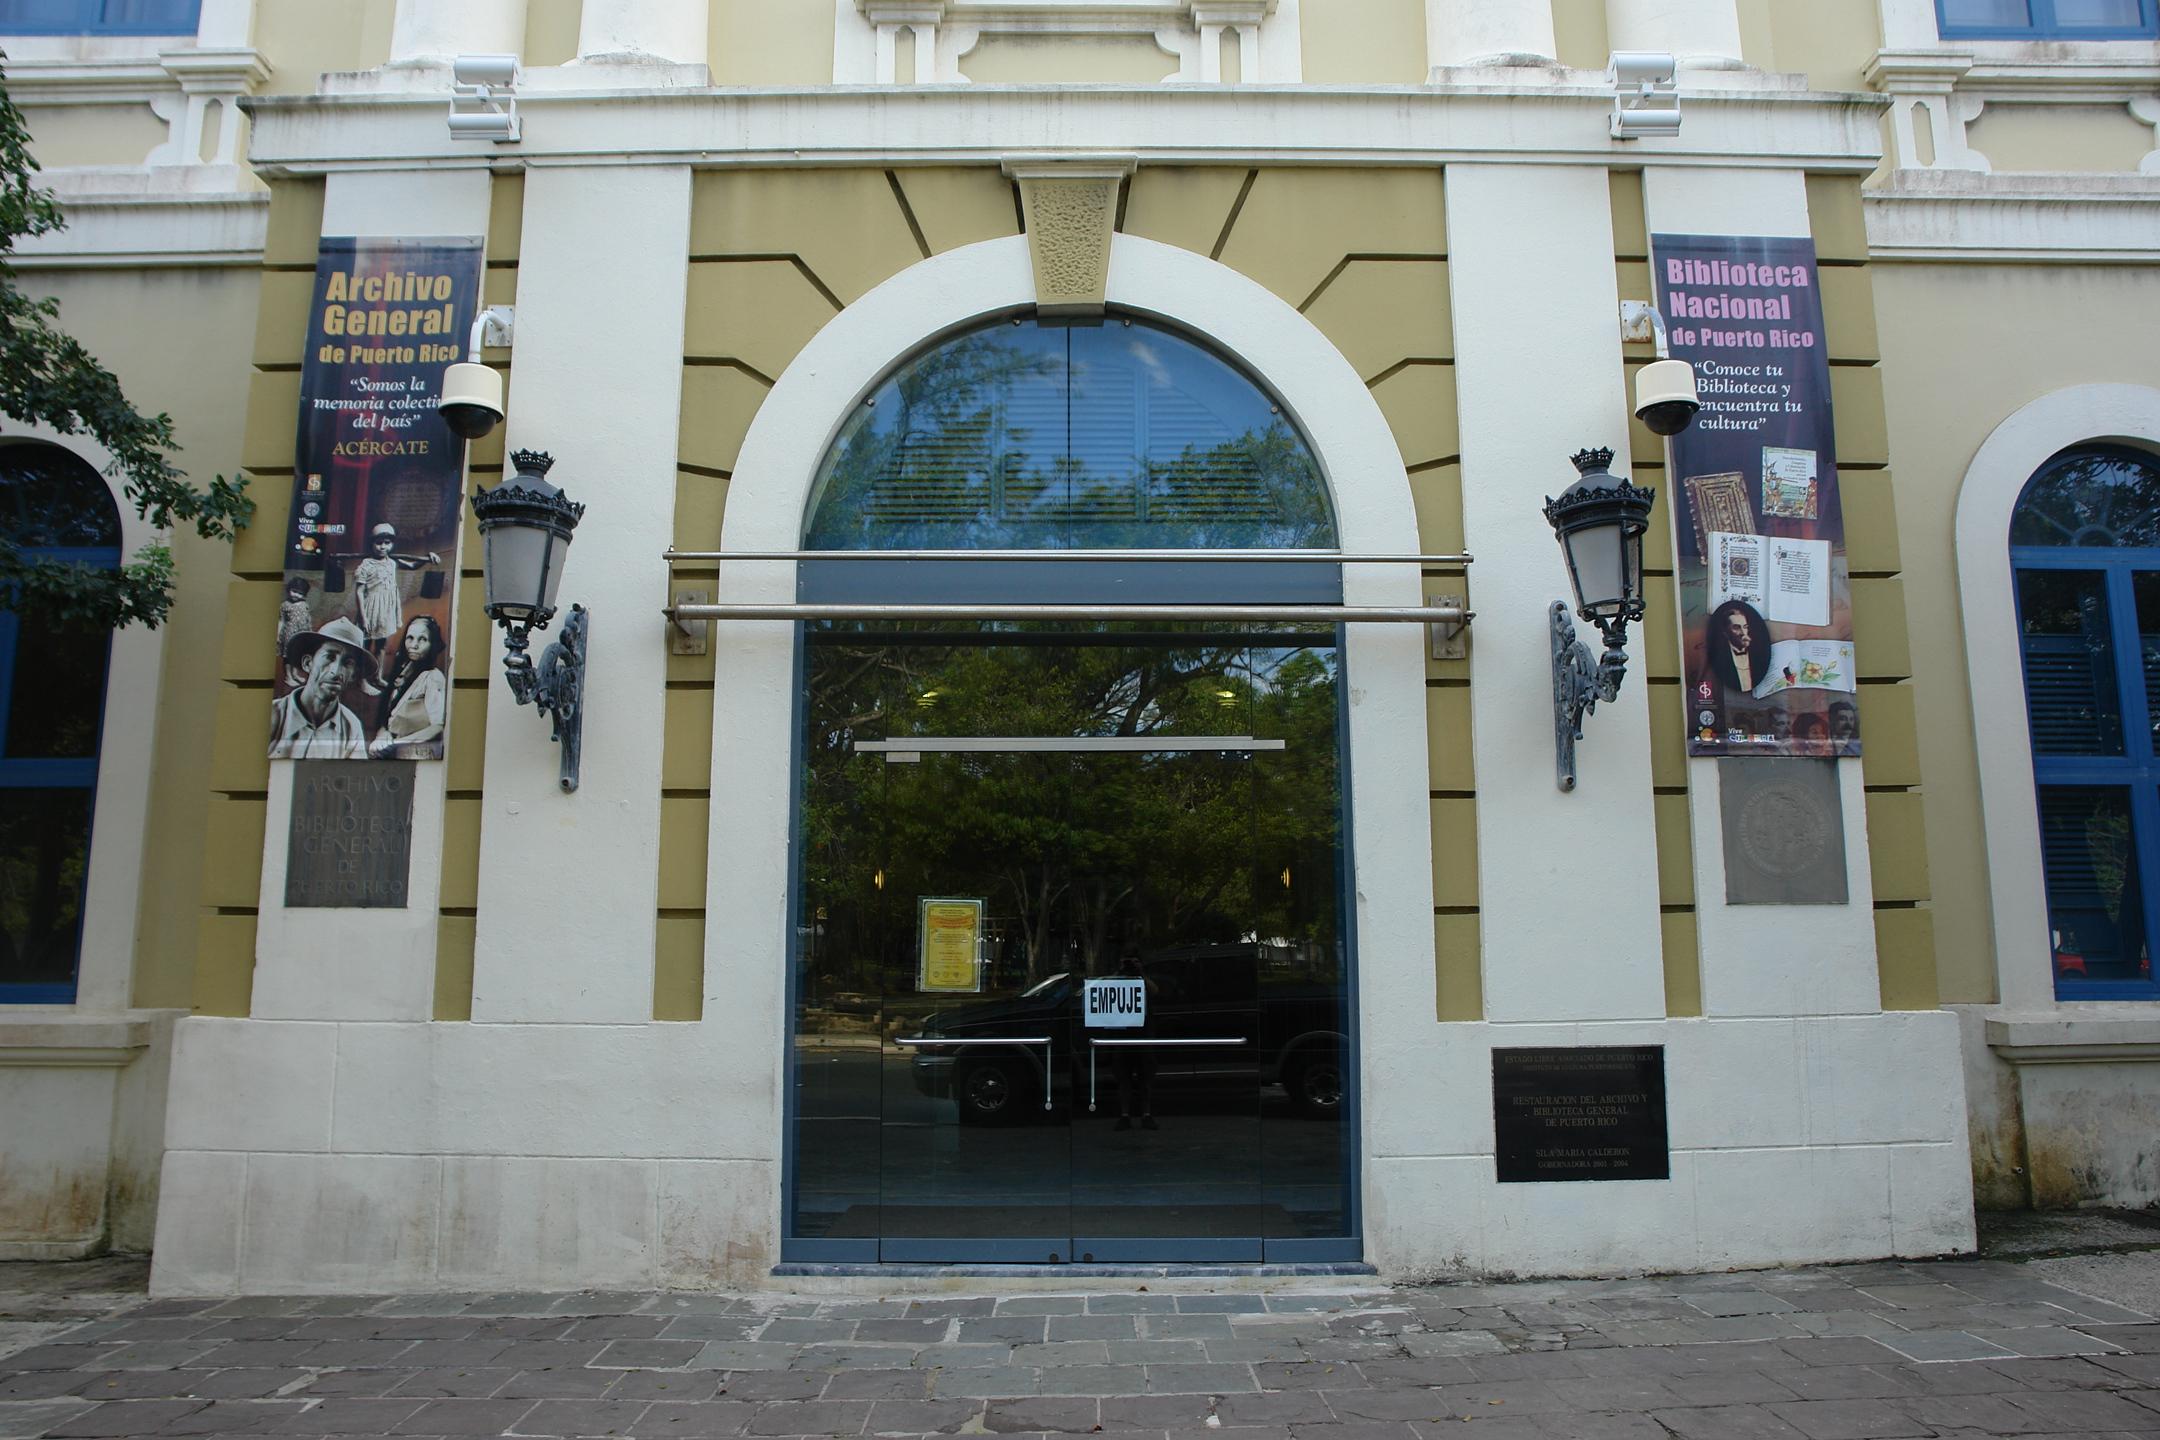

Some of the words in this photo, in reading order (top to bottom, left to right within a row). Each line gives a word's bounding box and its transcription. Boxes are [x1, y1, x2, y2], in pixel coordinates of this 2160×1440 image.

[1666, 258, 1809, 287] Biblioteca
[326, 271, 453, 301] Archivo
[1669, 291, 1791, 320] Nacional
[323, 304, 454, 336] General
[1672, 327, 1696, 346] de
[1700, 328, 1765, 348] Puerto
[1769, 330, 1814, 348] Rico
[319, 344, 345, 363] de
[350, 344, 414, 364] Puerto
[419, 344, 459, 362] Rico
[1694, 360, 1760, 377] “Conoce
[1766, 364, 1783, 377] tu
[350, 376, 406, 392] “Somos
[410, 376, 425, 391] la
[1696, 378, 1777, 394] Biblioteca
[1781, 384, 1791, 398] y
[313, 395, 384, 410] memoria
[1699, 400, 1780, 413] encuentra
[1784, 400, 1802, 413] tu
[352, 414, 376, 428] del
[380, 413, 421, 431] país”
[1699, 415, 1766, 431] cultura”
[332, 438, 429, 456] ACÉRCATE
[304, 775, 402, 793] ARCHIVO
[344, 795, 358, 813] Y
[294, 815, 408, 833] BIBLIOTECA
[303, 836, 402, 854] GENERAL
[338, 859, 358, 874] DE
[1090, 987, 1142, 1014] EMPUJE
[1512, 1096, 1577, 1105] RESTAURACION
[1580, 1095, 1597, 1104] DEL
[1599, 1094, 1639, 1104] ARCHIVO
[1640, 1094, 1648, 1103] Y
[1533, 1106, 1584, 1116] BIBLIOTECA
[1586, 1106, 1628, 1115] GENERAL
[1545, 1118, 1557, 1127] DE
[1559, 1118, 1595, 1126] PUERTO
[1597, 1117, 1618, 1126] RICO
